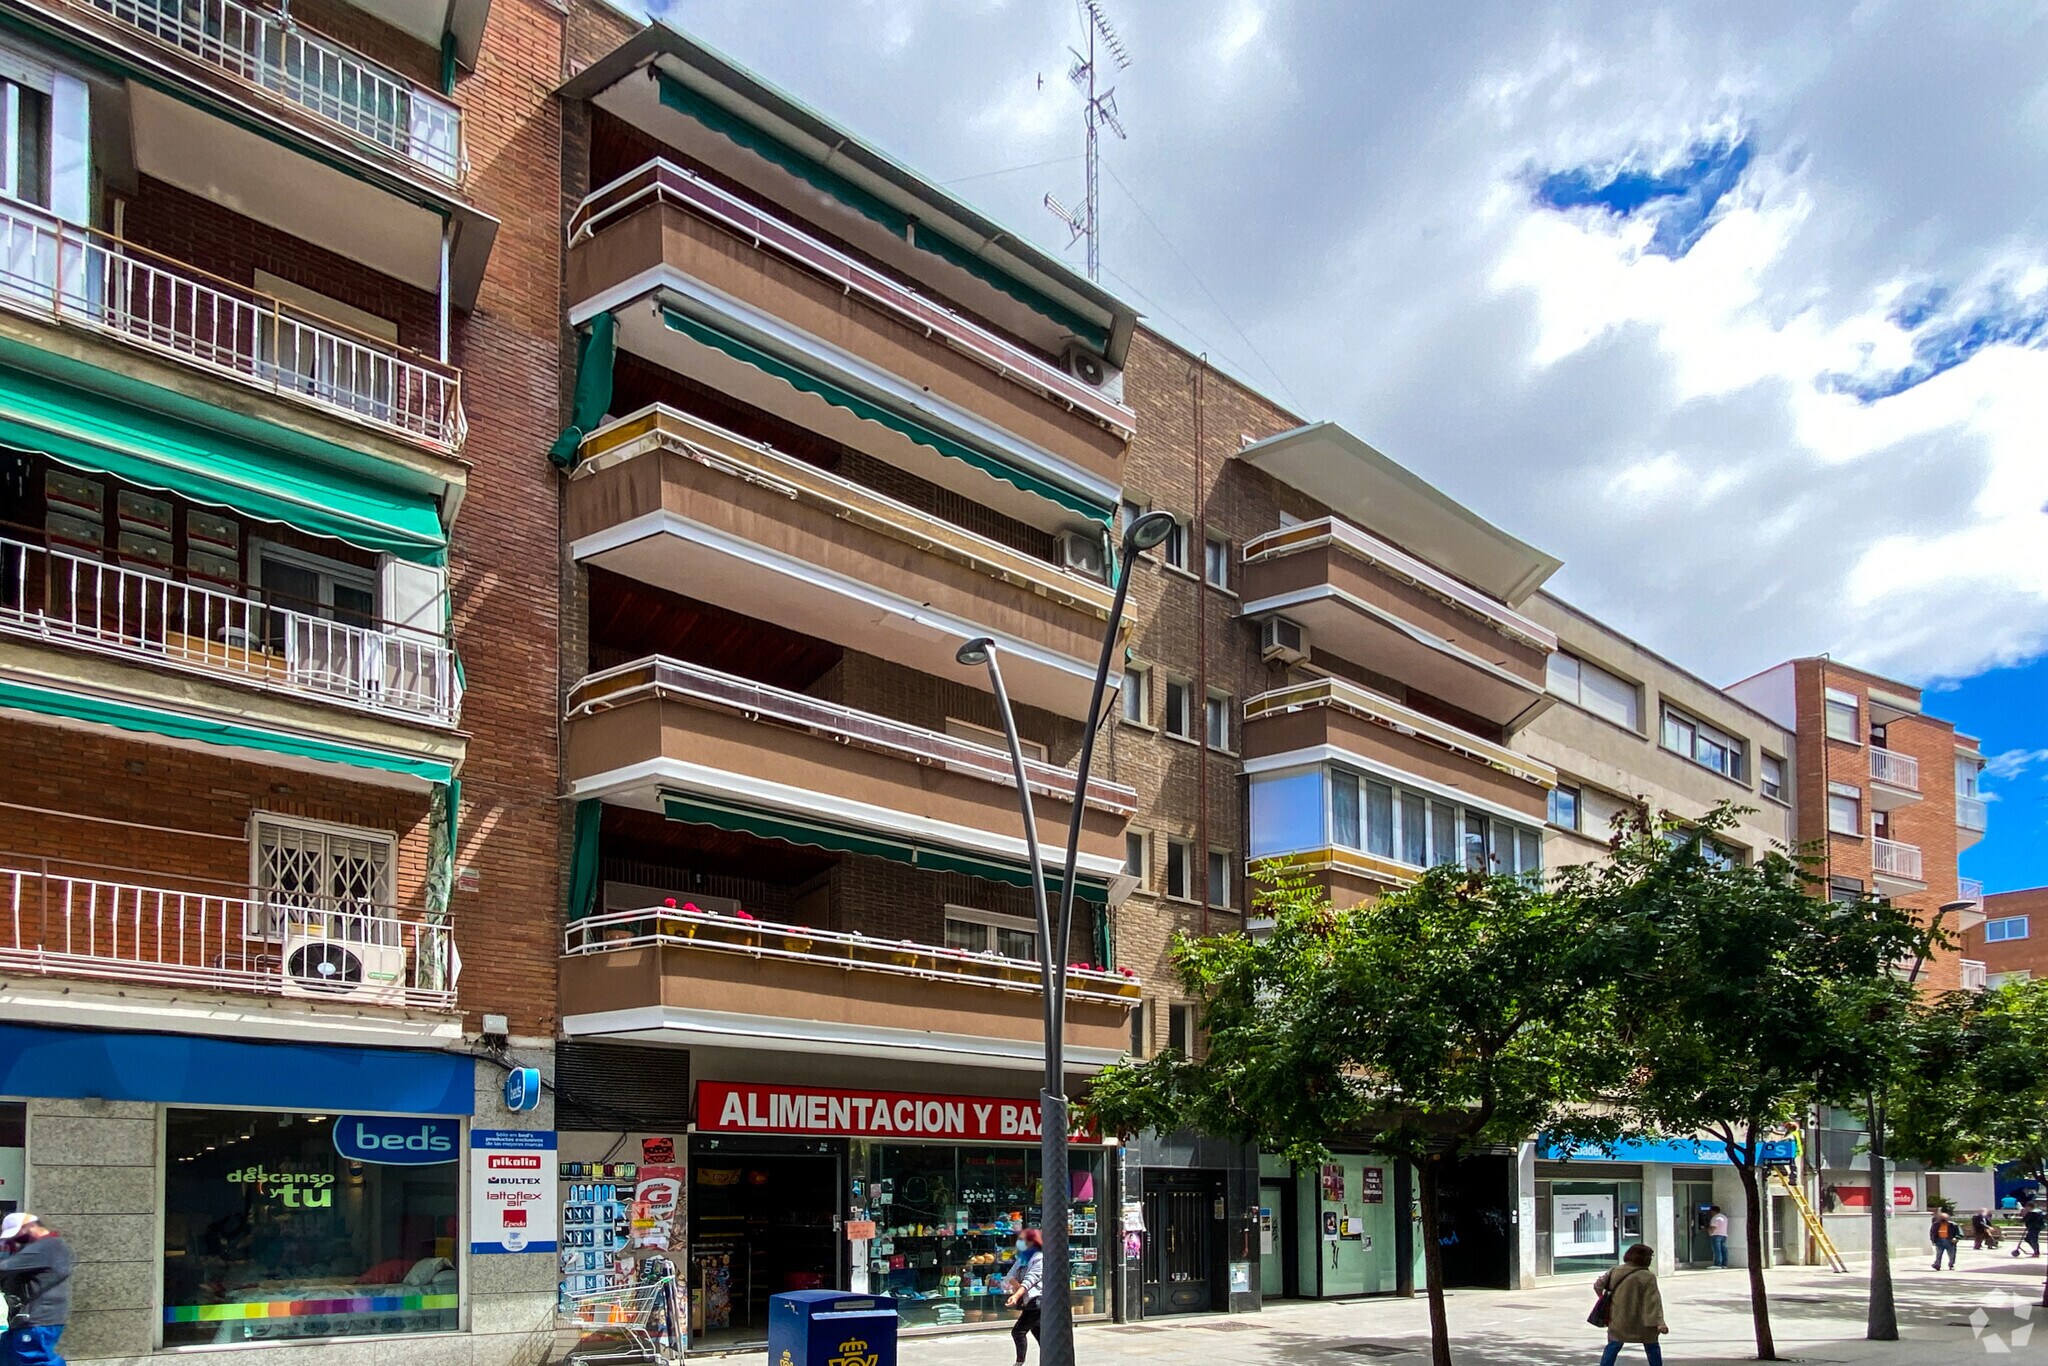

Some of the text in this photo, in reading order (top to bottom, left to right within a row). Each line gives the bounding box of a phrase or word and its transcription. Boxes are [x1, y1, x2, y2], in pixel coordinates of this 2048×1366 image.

[719, 1092, 965, 1134] ALIMENTACION
[972, 1103, 993, 1134] Y
[356, 1122, 452, 1151] bed's
[492, 1157, 538, 1169] pikolin
[226, 1169, 335, 1184] descanso
[246, 1164, 263, 1176] el
[500, 1177, 541, 1185] BULTEX
[269, 1181, 332, 1208] y tú
[486, 1191, 542, 1200] lattoflex
